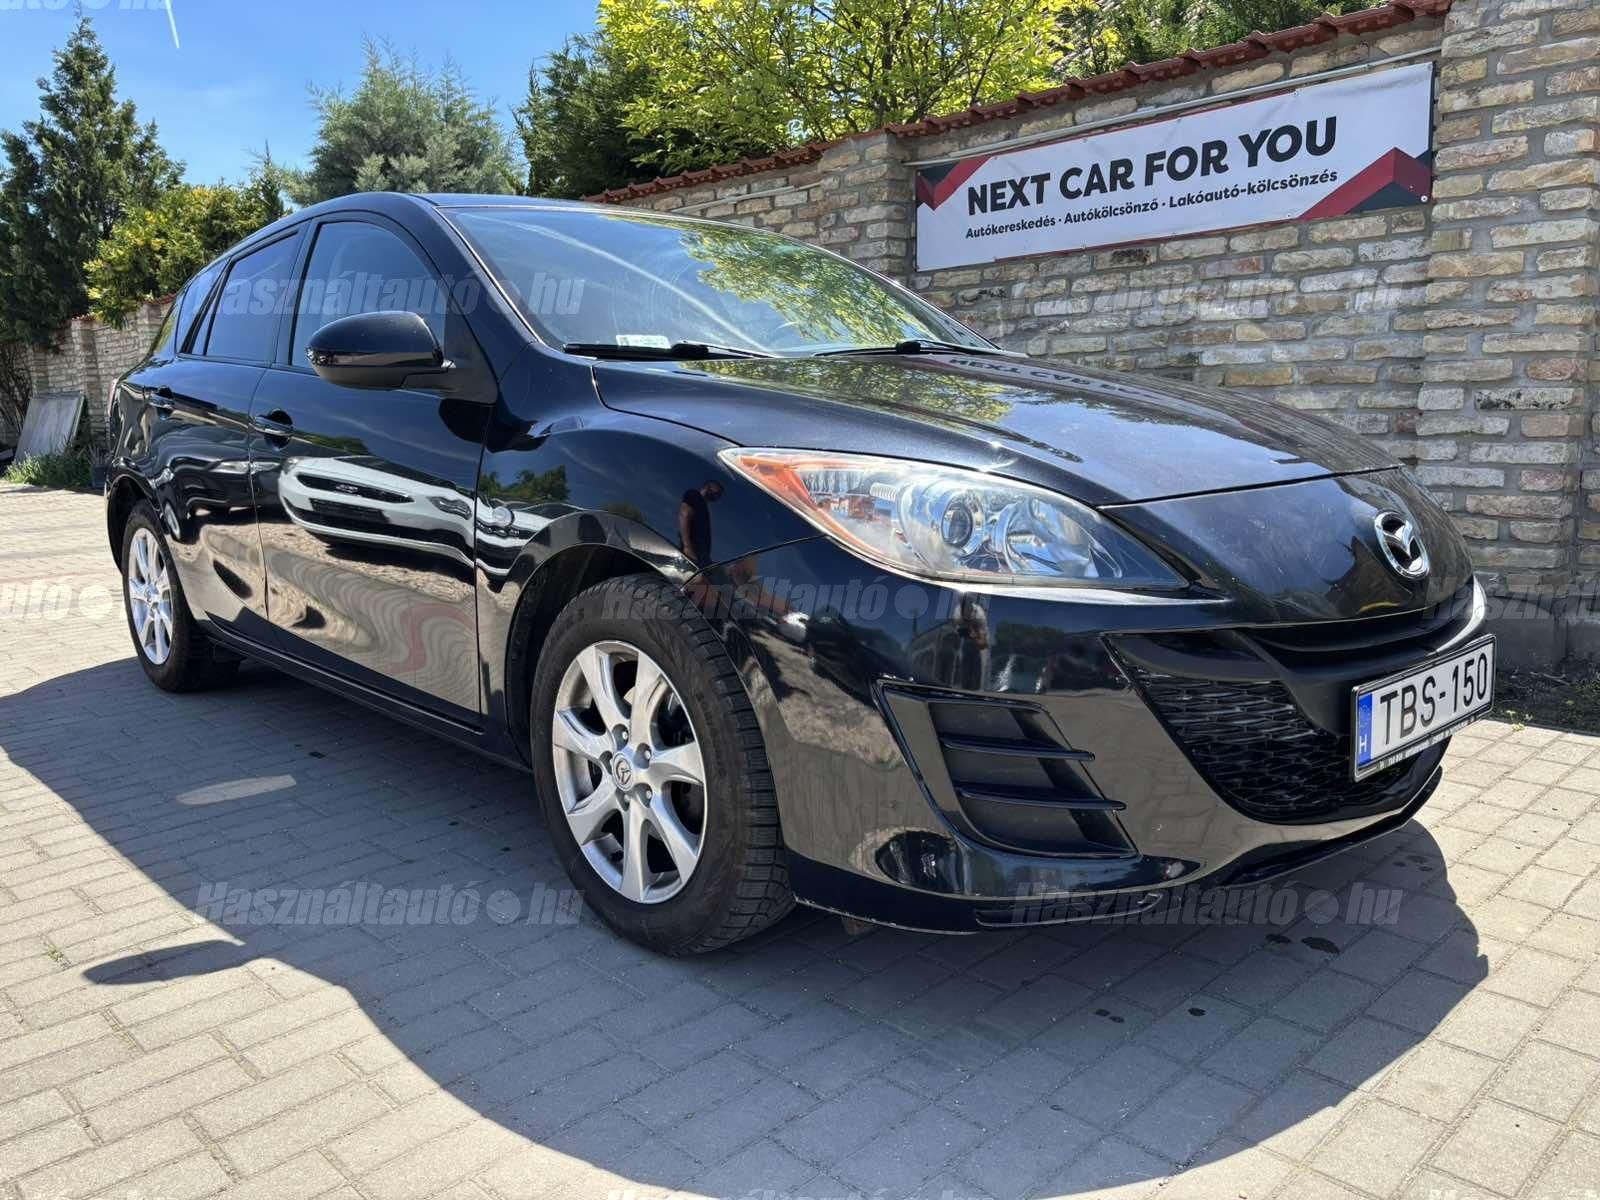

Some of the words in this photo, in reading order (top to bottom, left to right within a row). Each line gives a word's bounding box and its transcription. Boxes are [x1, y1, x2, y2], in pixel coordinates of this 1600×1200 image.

[965, 215, 1056, 239] Autókereskedés
[1064, 200, 1159, 225] Autókölcsönző
[1169, 169, 1338, 208] Lakóautó-kölcsönzés
[968, 172, 1051, 216] NEXT
[1059, 158, 1136, 200] CAR
[1144, 139, 1229, 187] FOR
[1238, 116, 1337, 168] YOU
[1379, 652, 1488, 746] TBS-150
